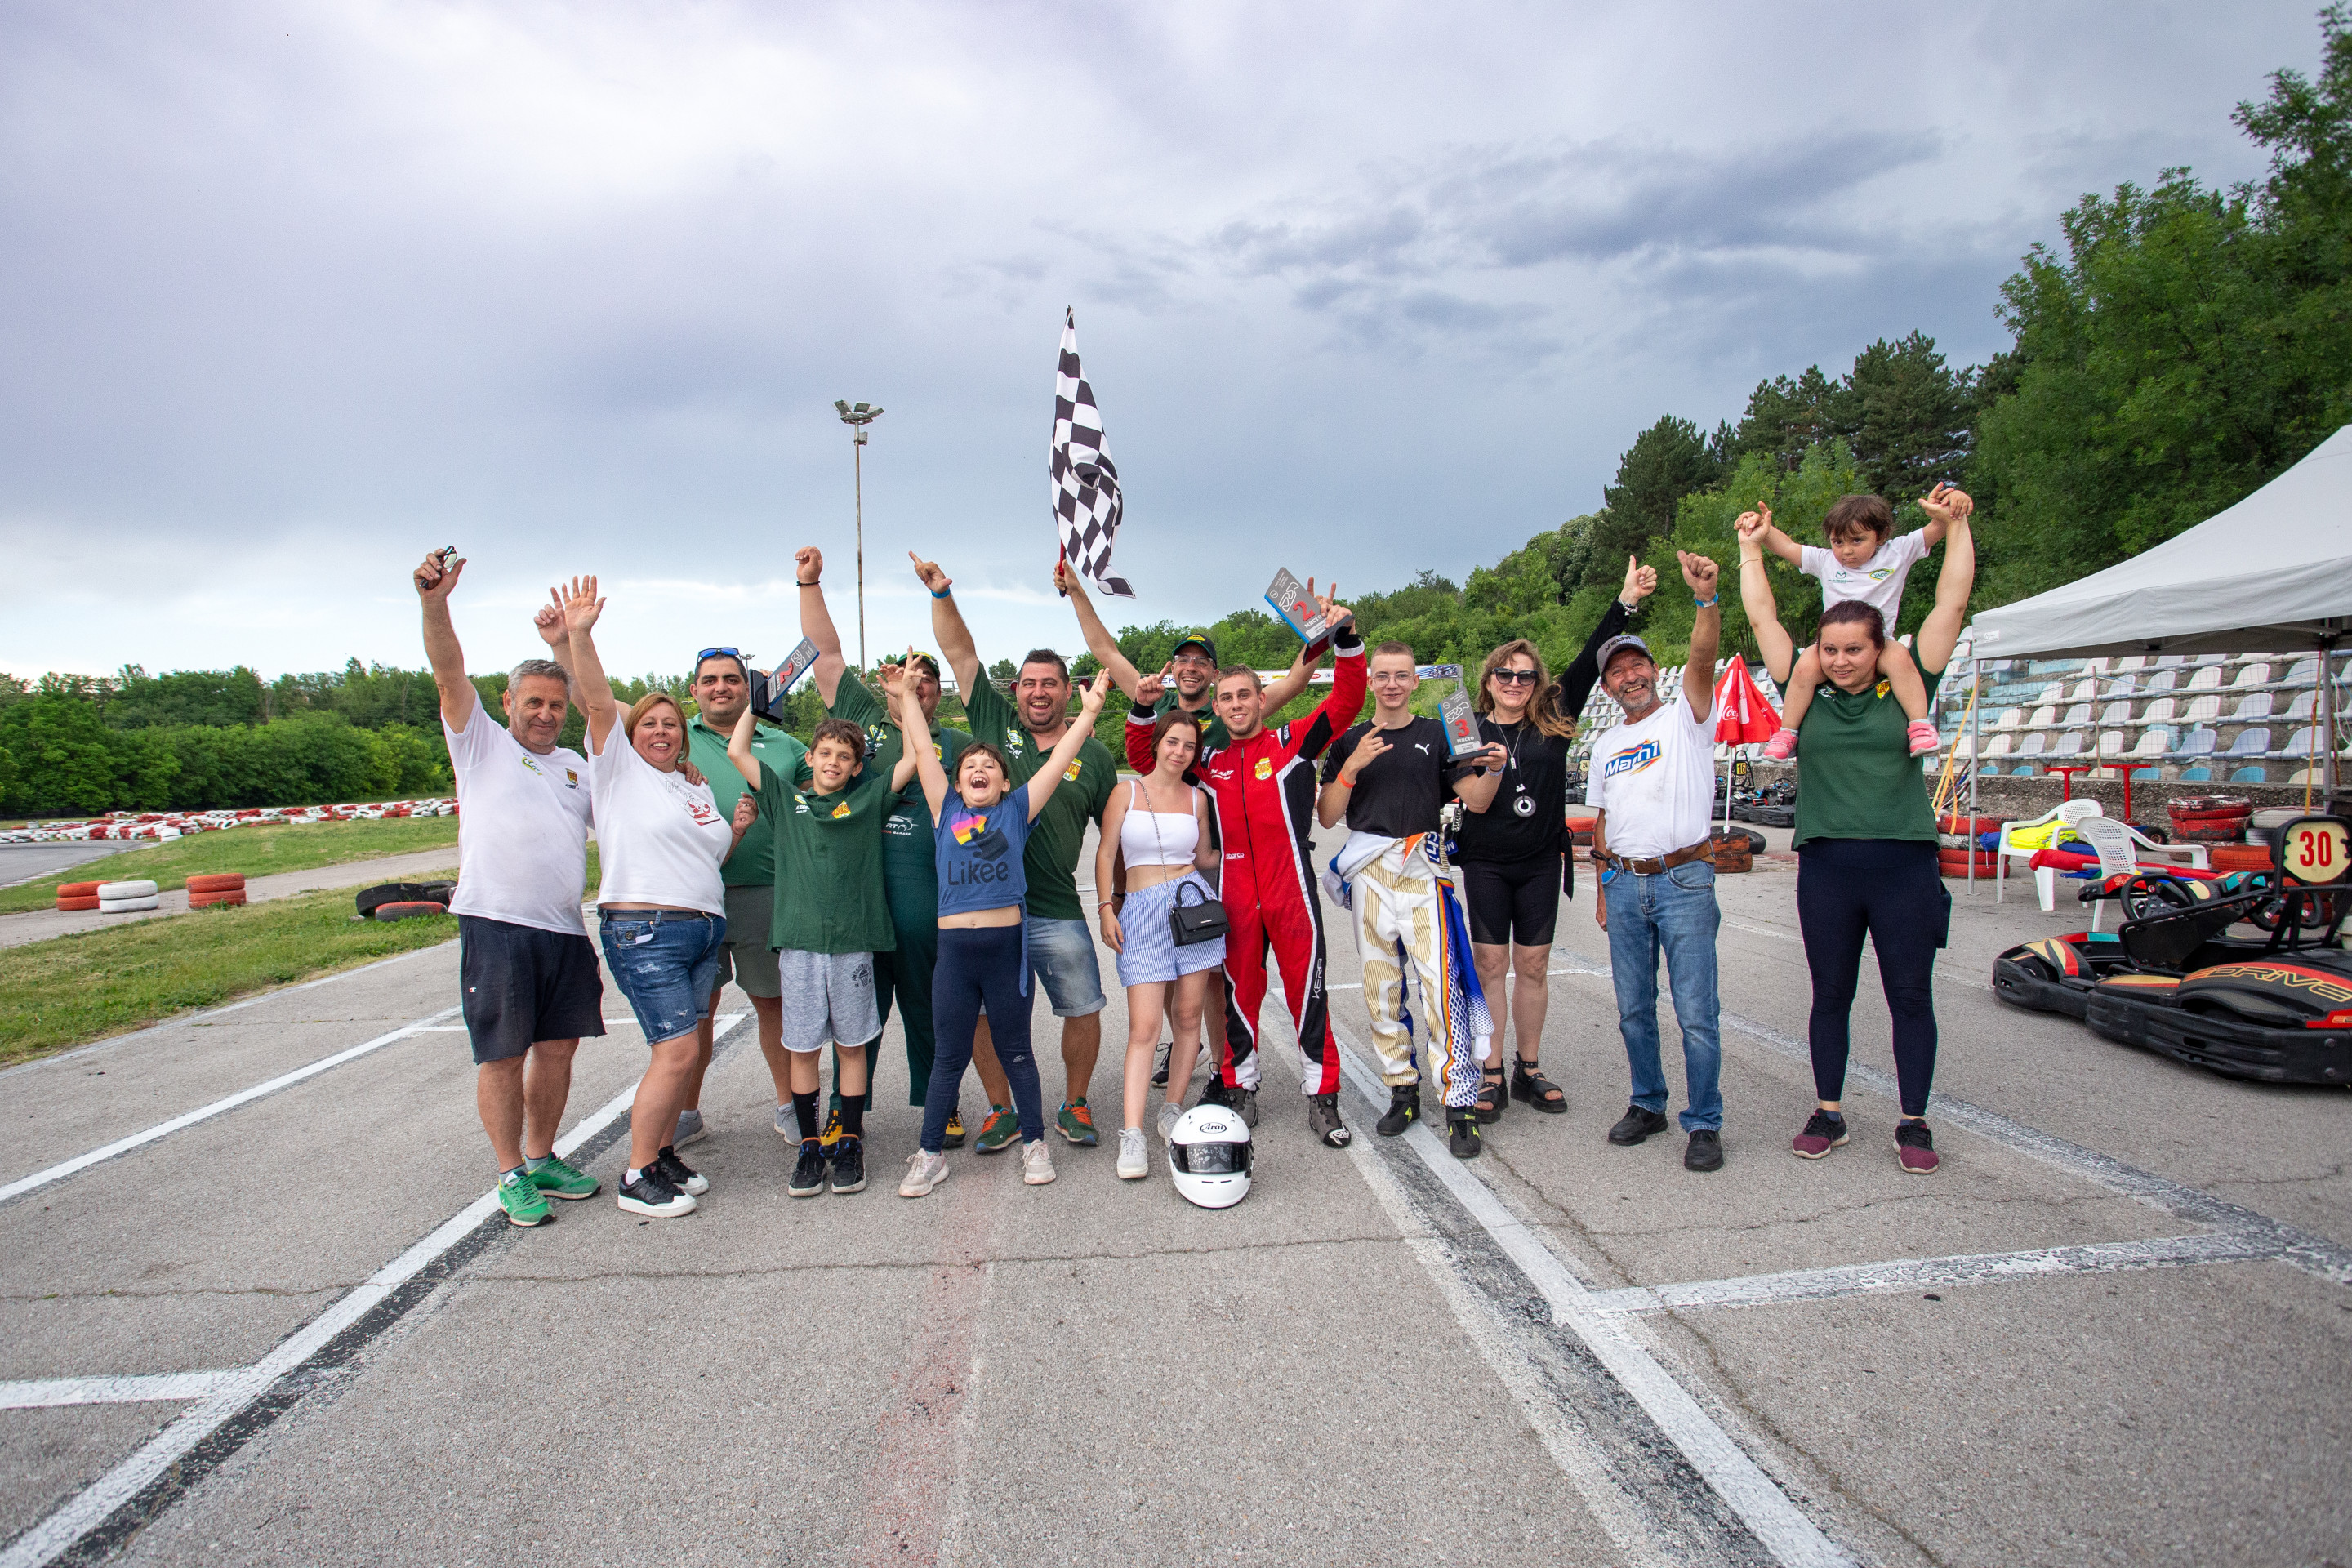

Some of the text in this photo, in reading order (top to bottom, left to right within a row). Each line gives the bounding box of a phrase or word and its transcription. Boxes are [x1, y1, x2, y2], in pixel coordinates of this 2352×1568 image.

[1293, 601, 1316, 621] 2
[778, 662, 794, 684] 2
[1455, 719, 1470, 737] 3
[1738, 764, 1745, 774] 16
[1426, 831, 1441, 863] ch1
[2299, 831, 2332, 867] 30
[948, 860, 1009, 886] Likee
[1204, 1123, 1224, 1131] Arai
